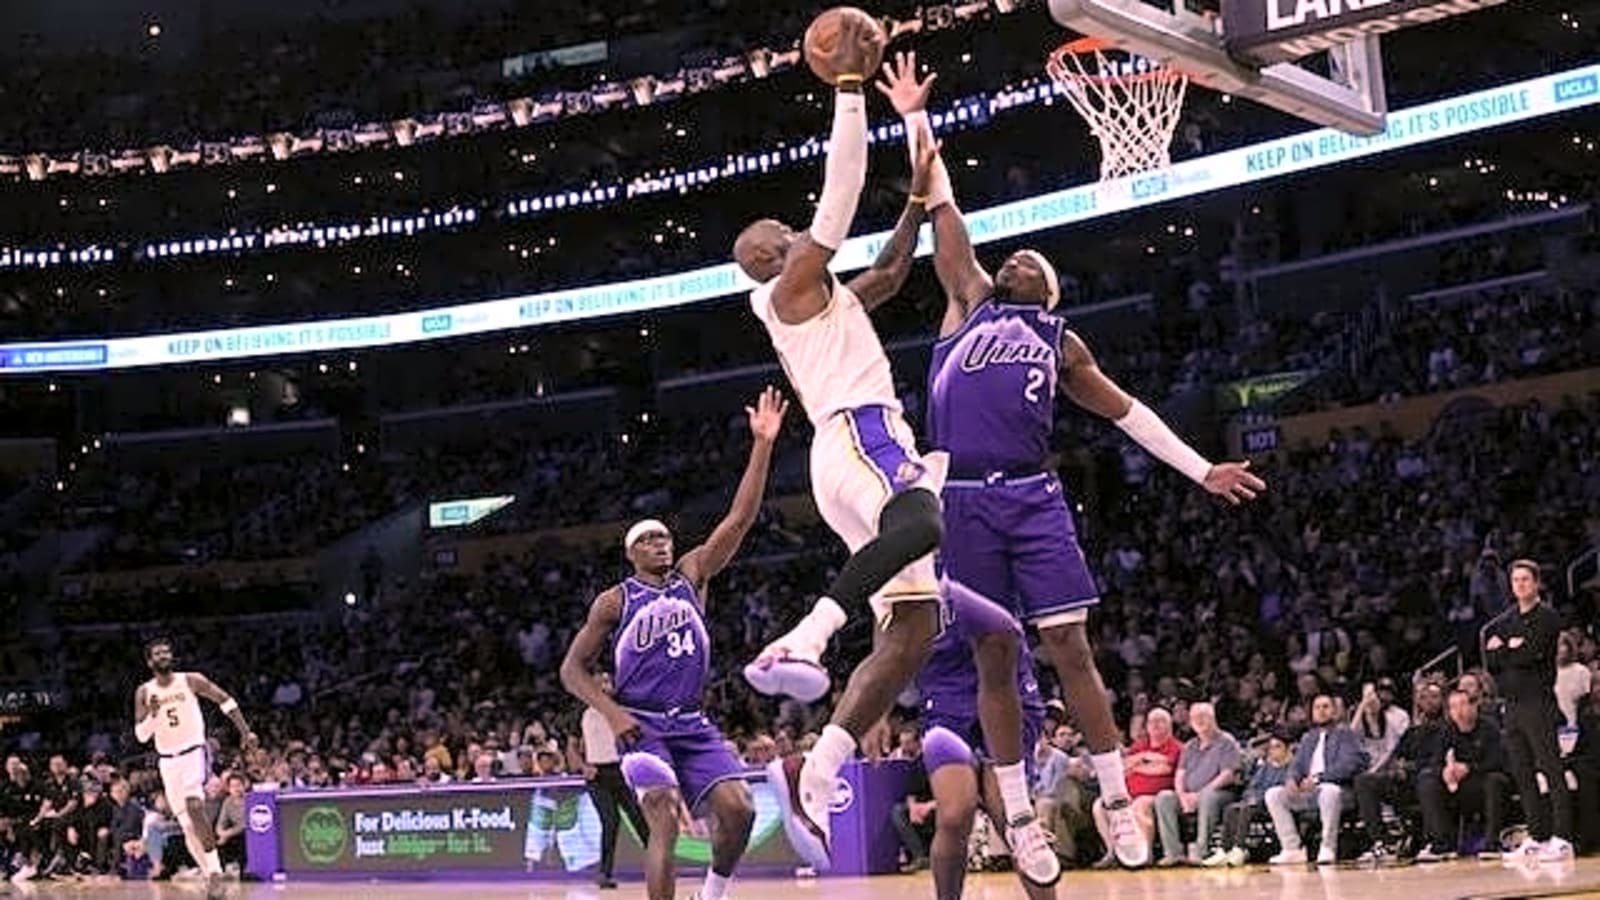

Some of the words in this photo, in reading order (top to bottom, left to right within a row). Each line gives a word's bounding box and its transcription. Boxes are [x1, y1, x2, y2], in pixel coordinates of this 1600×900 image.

[1557, 76, 1594, 99] UCLA
[867, 104, 981, 143] LEGDARY
[1246, 147, 1286, 174] KEEP
[1292, 141, 1313, 163] ON
[1408, 111, 1440, 134] IT'S
[1445, 91, 1529, 130] POSSIBLE
[508, 187, 616, 215] LEGENDARY
[1031, 193, 1098, 222] POSSIBLE
[146, 235, 256, 259] LEGENDARY
[519, 299, 551, 318] KEEP
[555, 299, 573, 313] ON
[168, 339, 201, 355] KEEP
[204, 339, 222, 353] ON
[1024, 368, 1045, 402] 2
[667, 630, 695, 658] 34
[167, 707, 179, 727] 5
[355, 812, 380, 832] For
[382, 809, 450, 831] Delicious
[452, 807, 516, 831] K-Food,
[355, 835, 385, 858] Just
